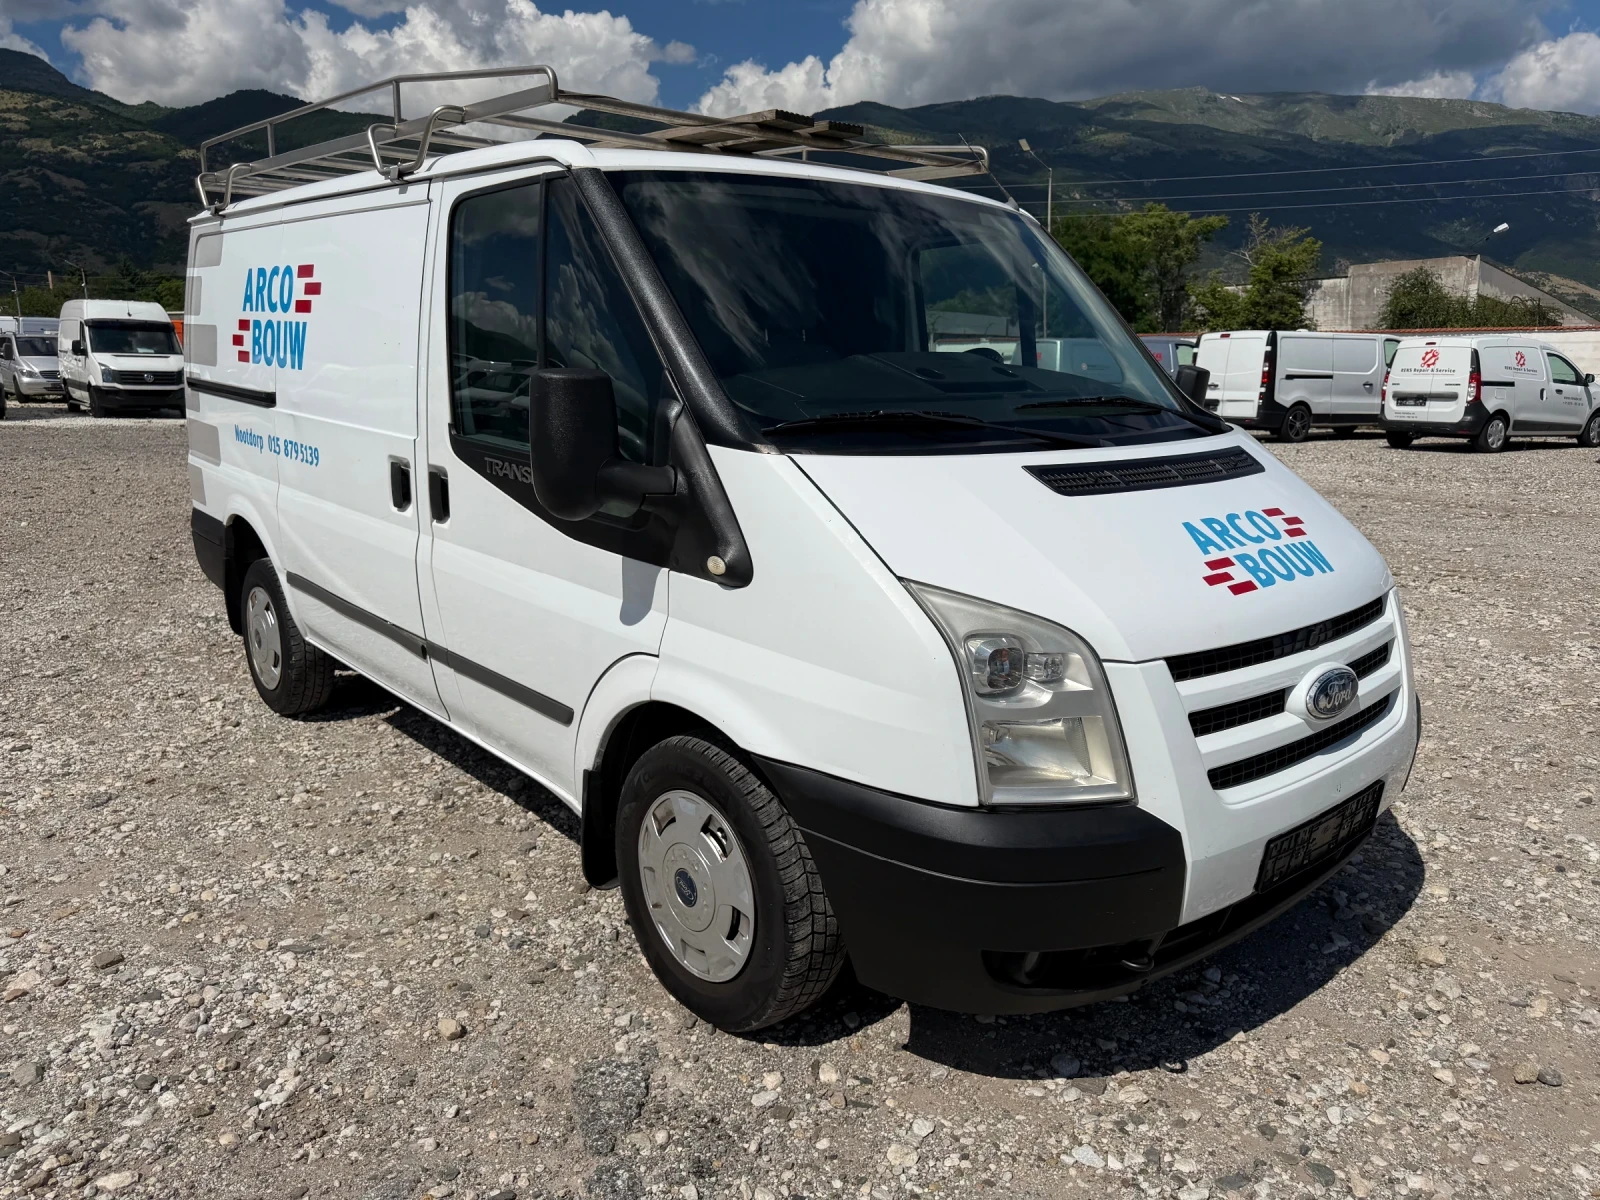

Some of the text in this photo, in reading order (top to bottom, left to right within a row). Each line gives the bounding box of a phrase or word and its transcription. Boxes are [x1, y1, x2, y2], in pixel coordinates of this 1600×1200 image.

[242, 265, 294, 313] ARCO
[251, 319, 308, 370] BOUW
[267, 434, 281, 456] 015
[484, 457, 533, 485] TRANS
[1181, 510, 1282, 556] ARCO
[1232, 540, 1335, 588] BOUW
[1326, 680, 1352, 709] Ford
